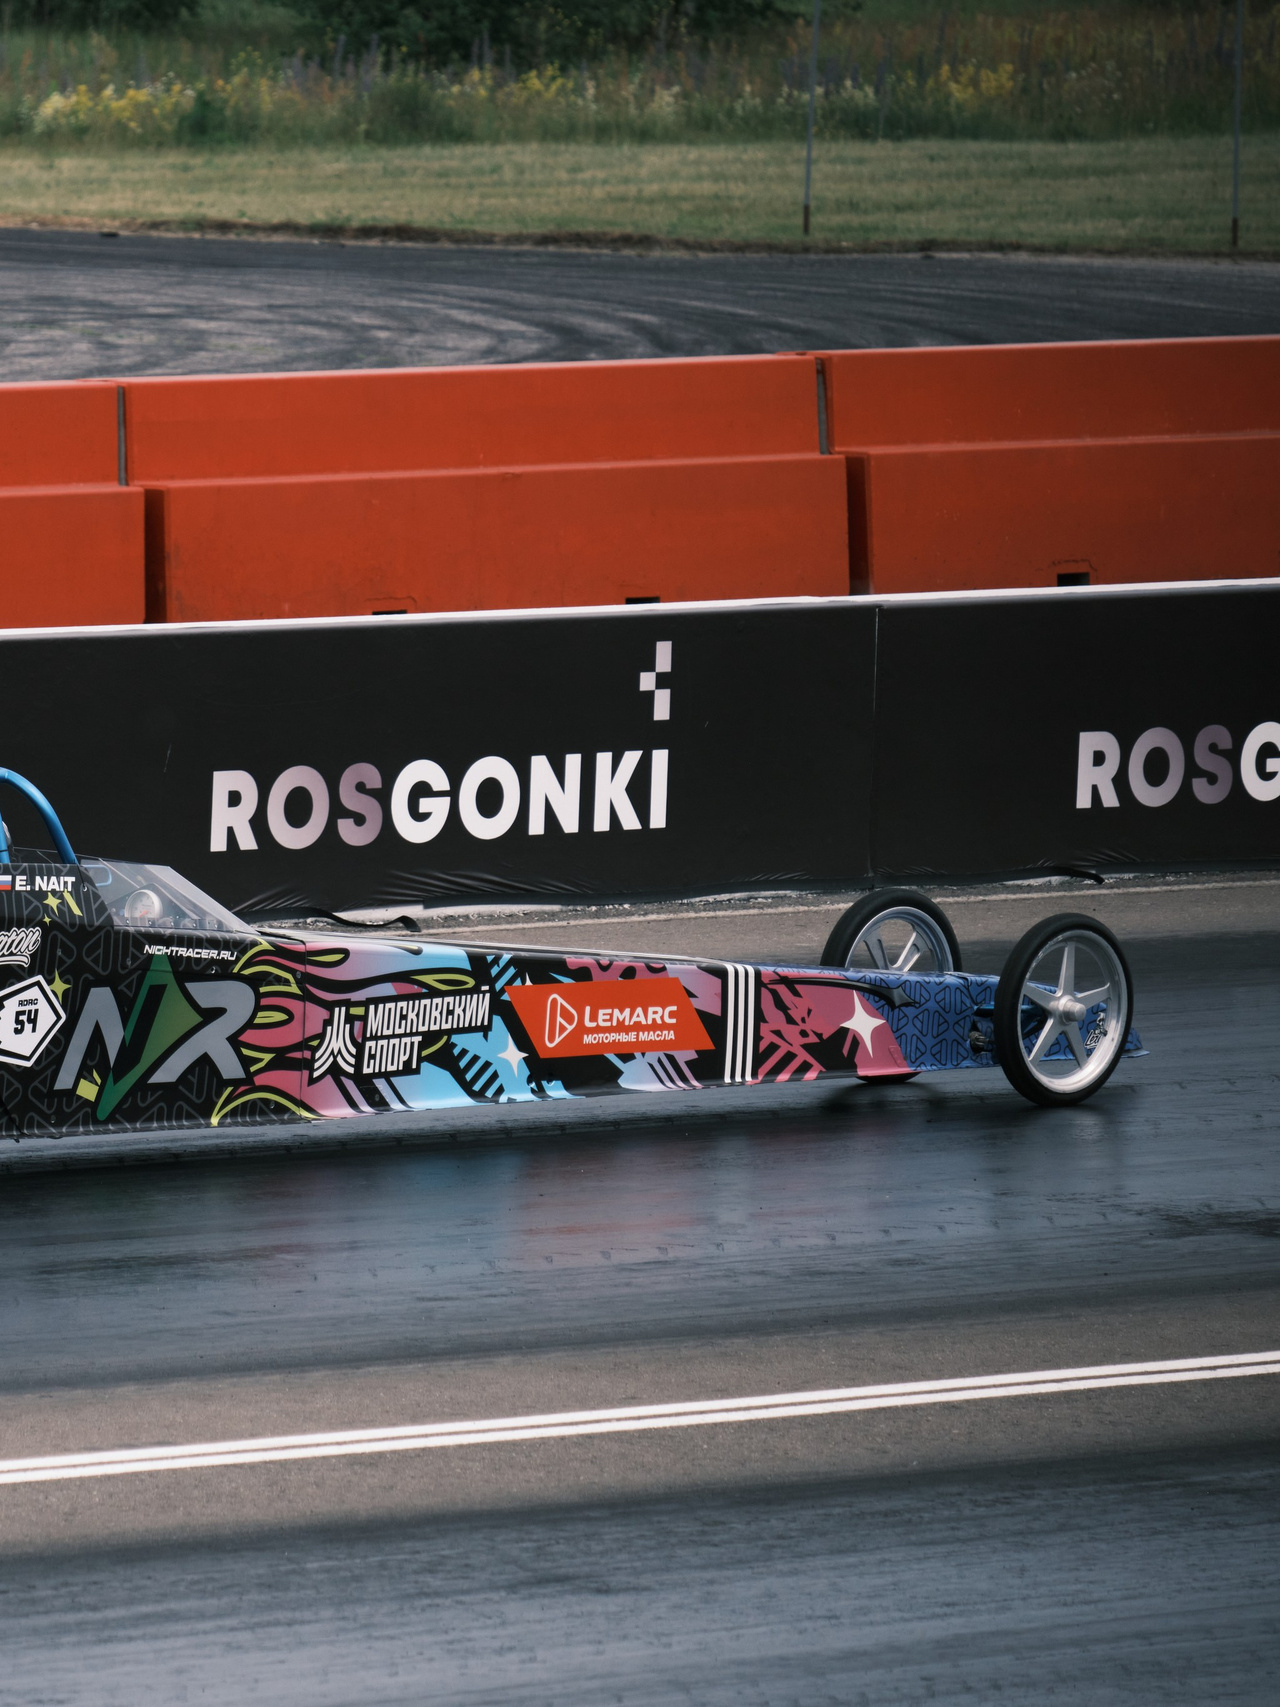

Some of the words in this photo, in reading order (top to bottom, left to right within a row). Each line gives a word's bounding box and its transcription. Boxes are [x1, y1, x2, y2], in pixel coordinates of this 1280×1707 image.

[210, 749, 669, 852] ROSGONKI
[15, 876, 31, 891] E.
[35, 876, 75, 891] NAIT
[144, 945, 237, 960] NIGHTRACER.RU
[13, 1009, 39, 1035] 54
[366, 985, 490, 1037] МОСКОВСКИЙ
[584, 1006, 677, 1027] LEMARC
[583, 1032, 637, 1044] МОТОРНЫЕ
[638, 1030, 675, 1041] МАСЛА
[362, 1035, 422, 1074] СПОРТ
